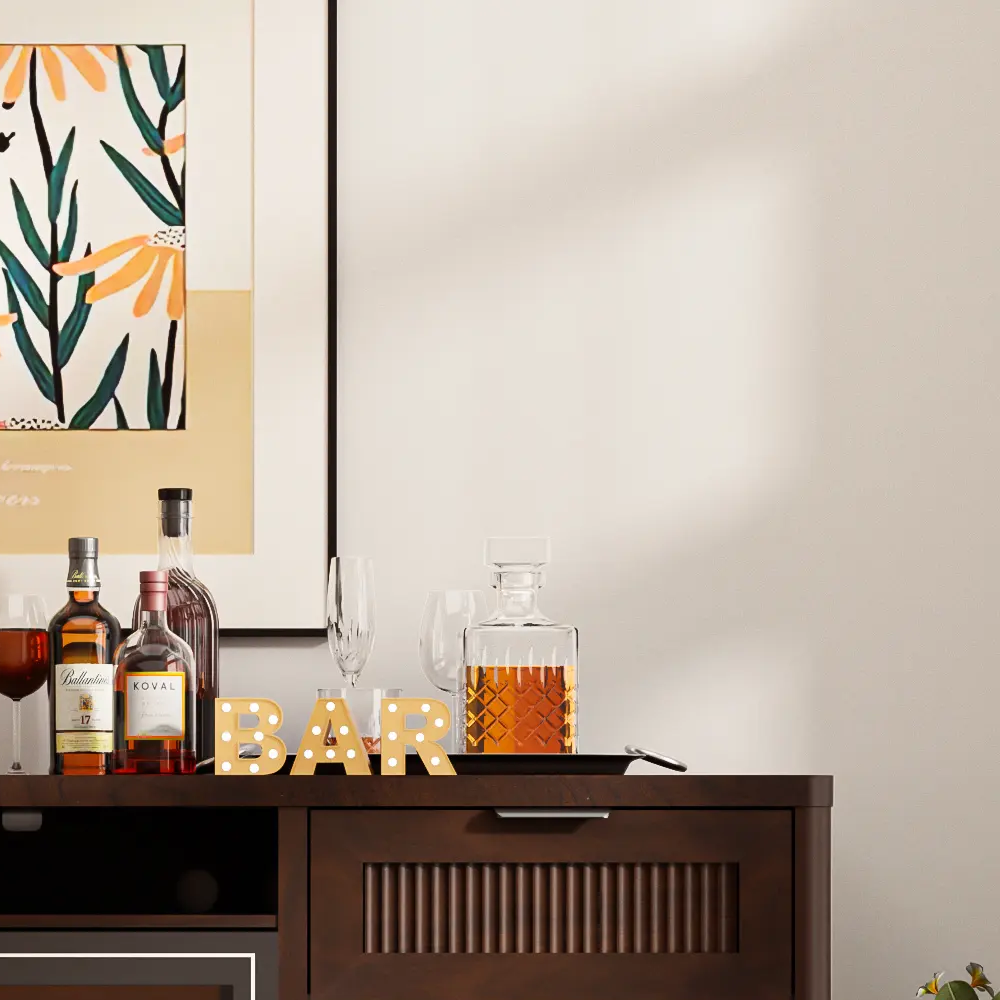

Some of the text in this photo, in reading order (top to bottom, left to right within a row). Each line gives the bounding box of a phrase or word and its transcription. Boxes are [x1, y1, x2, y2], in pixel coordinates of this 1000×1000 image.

[133, 681, 176, 691] KOVAL
[80, 715, 91, 725] 17
[214, 697, 458, 776] BAR
